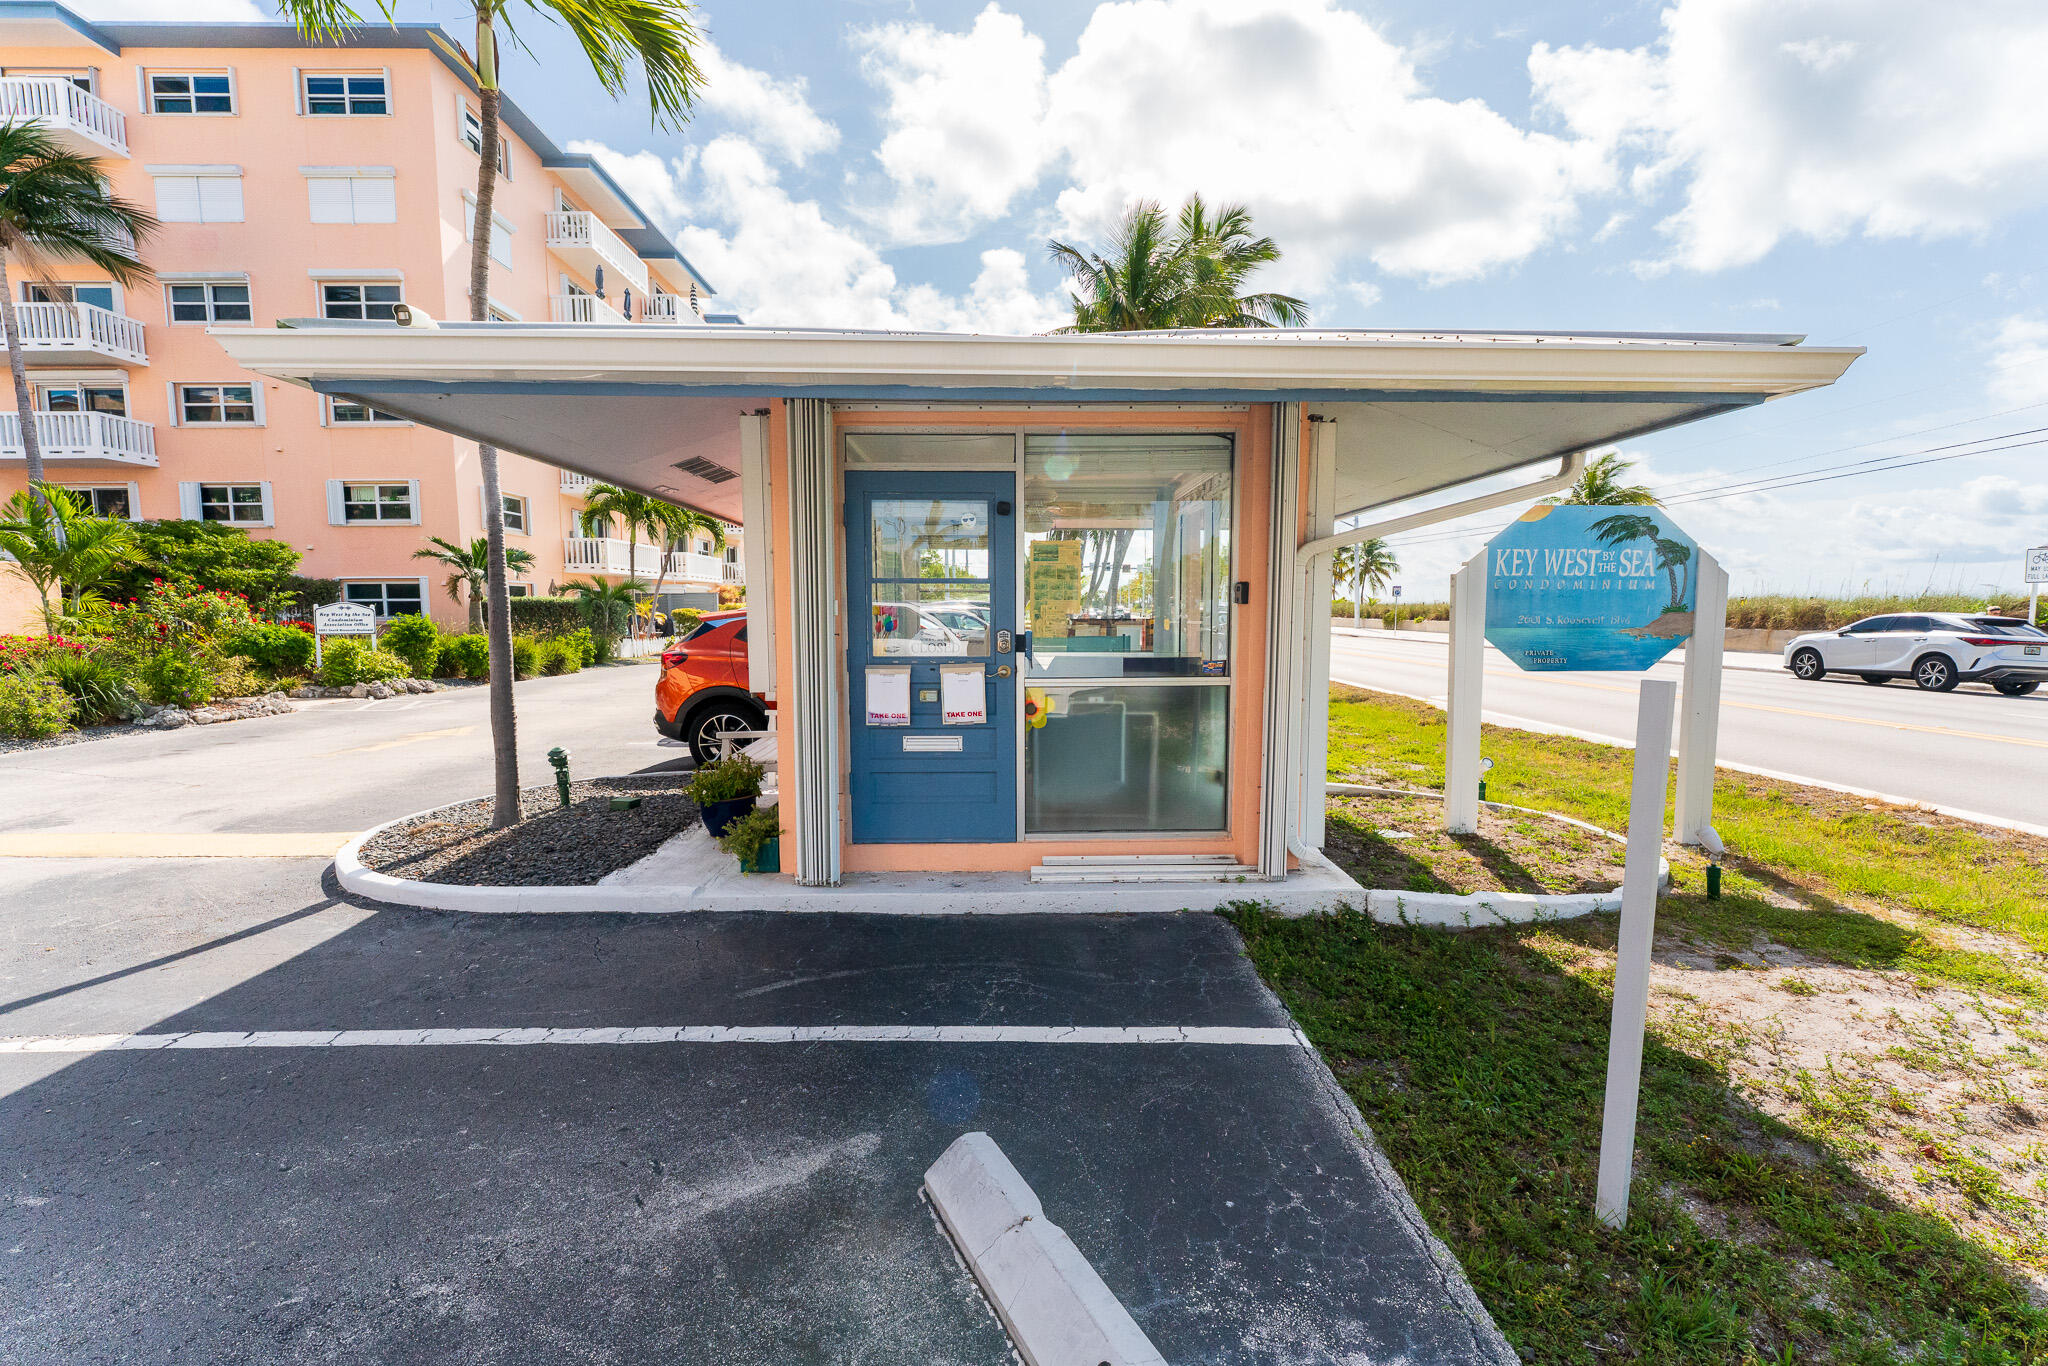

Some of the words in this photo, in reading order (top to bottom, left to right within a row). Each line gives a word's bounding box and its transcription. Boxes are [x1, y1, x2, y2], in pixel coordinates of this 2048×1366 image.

[1602, 551, 1617, 561] BY
[1494, 549, 1539, 577] KEY
[1544, 549, 1601, 577] WEST
[1598, 562, 1616, 573] THE
[1619, 549, 1656, 577] SEA
[1494, 579, 1656, 590] CONDOMINIUM
[1557, 615, 1605, 625] Roosevelt
